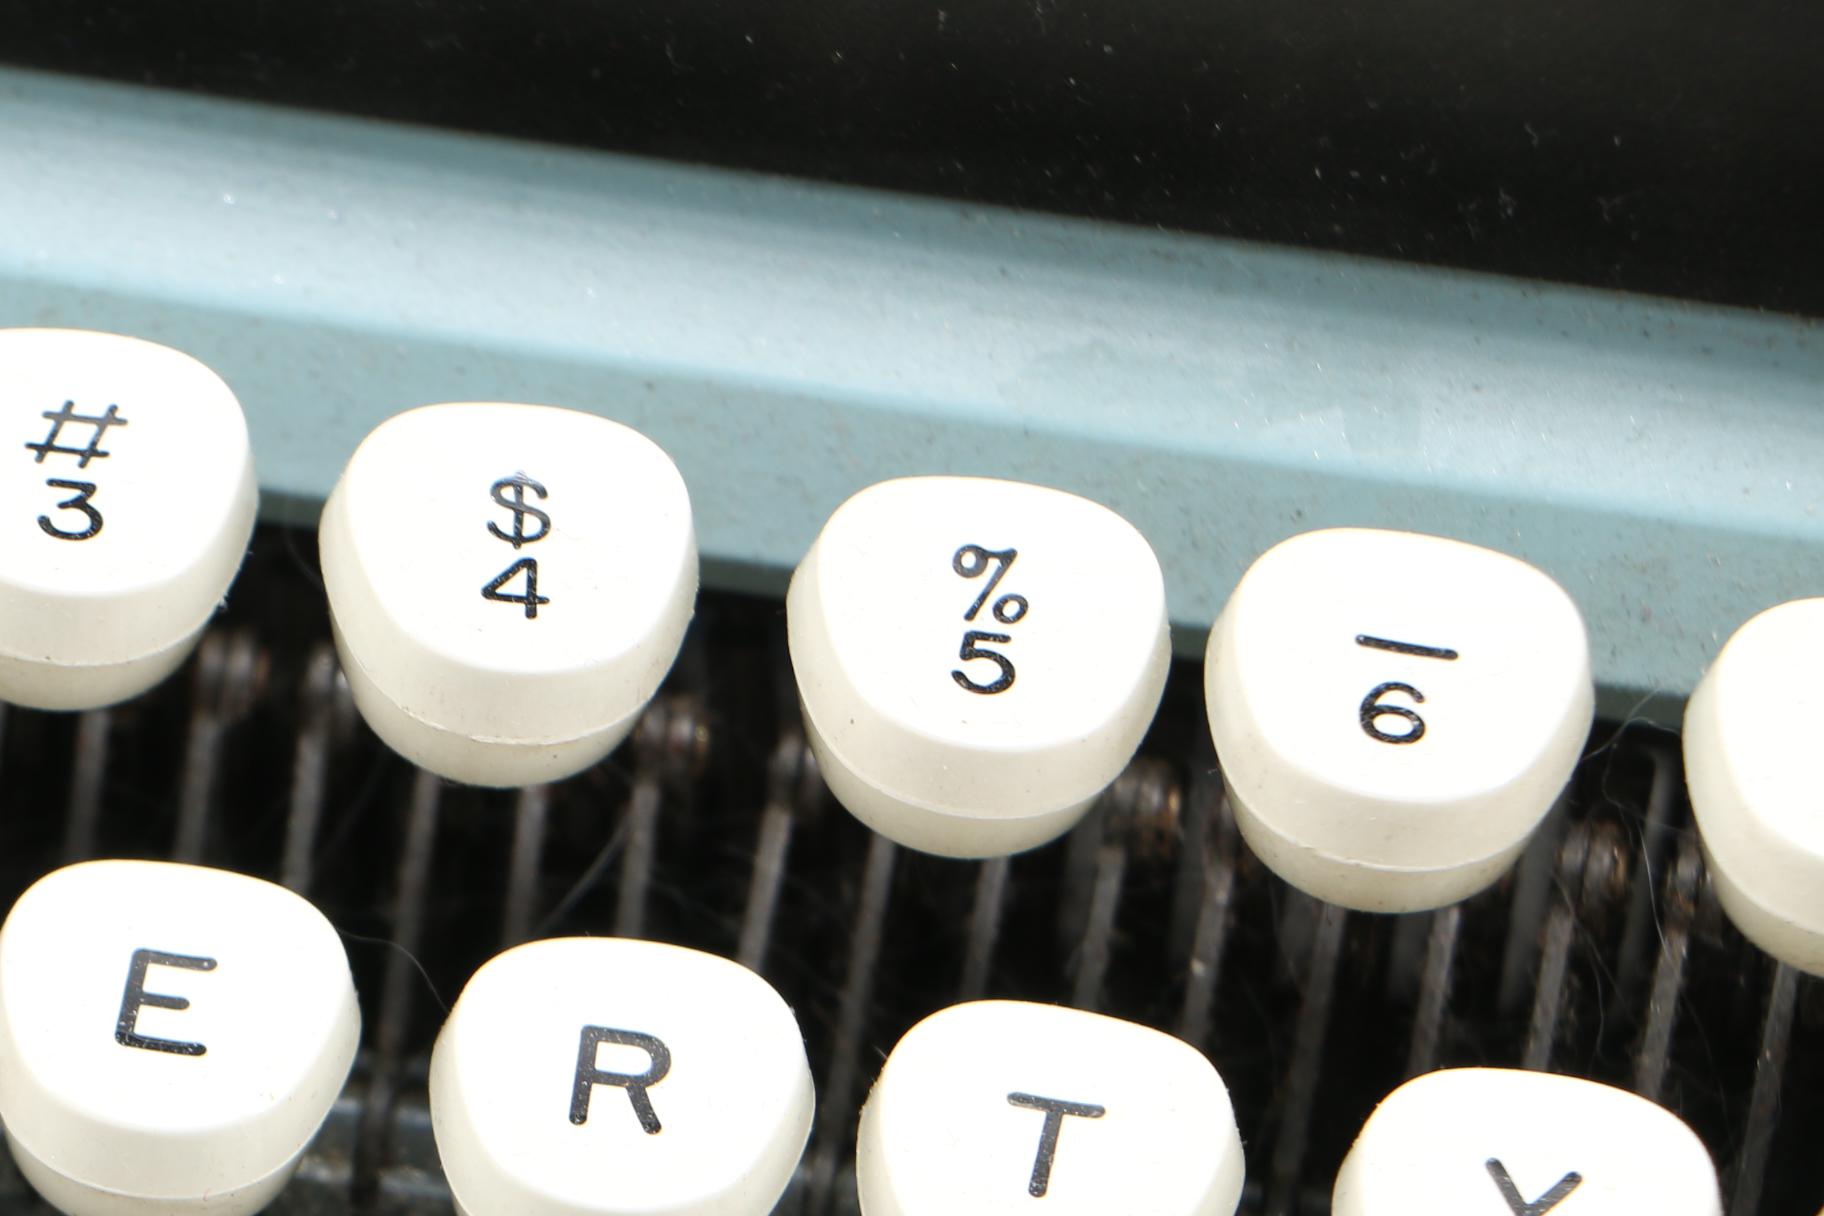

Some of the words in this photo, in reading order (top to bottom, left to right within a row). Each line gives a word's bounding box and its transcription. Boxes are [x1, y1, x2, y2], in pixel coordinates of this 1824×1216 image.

[26, 401, 126, 467] #
[38, 479, 103, 540] 3
[488, 473, 551, 549] $
[482, 558, 549, 619] 4
[954, 545, 1028, 623] %
[952, 631, 1015, 694] 5
[1360, 682, 1425, 744] 6
[115, 950, 216, 1056] E
[569, 1026, 670, 1134] R
[1008, 1093, 1105, 1197] T
